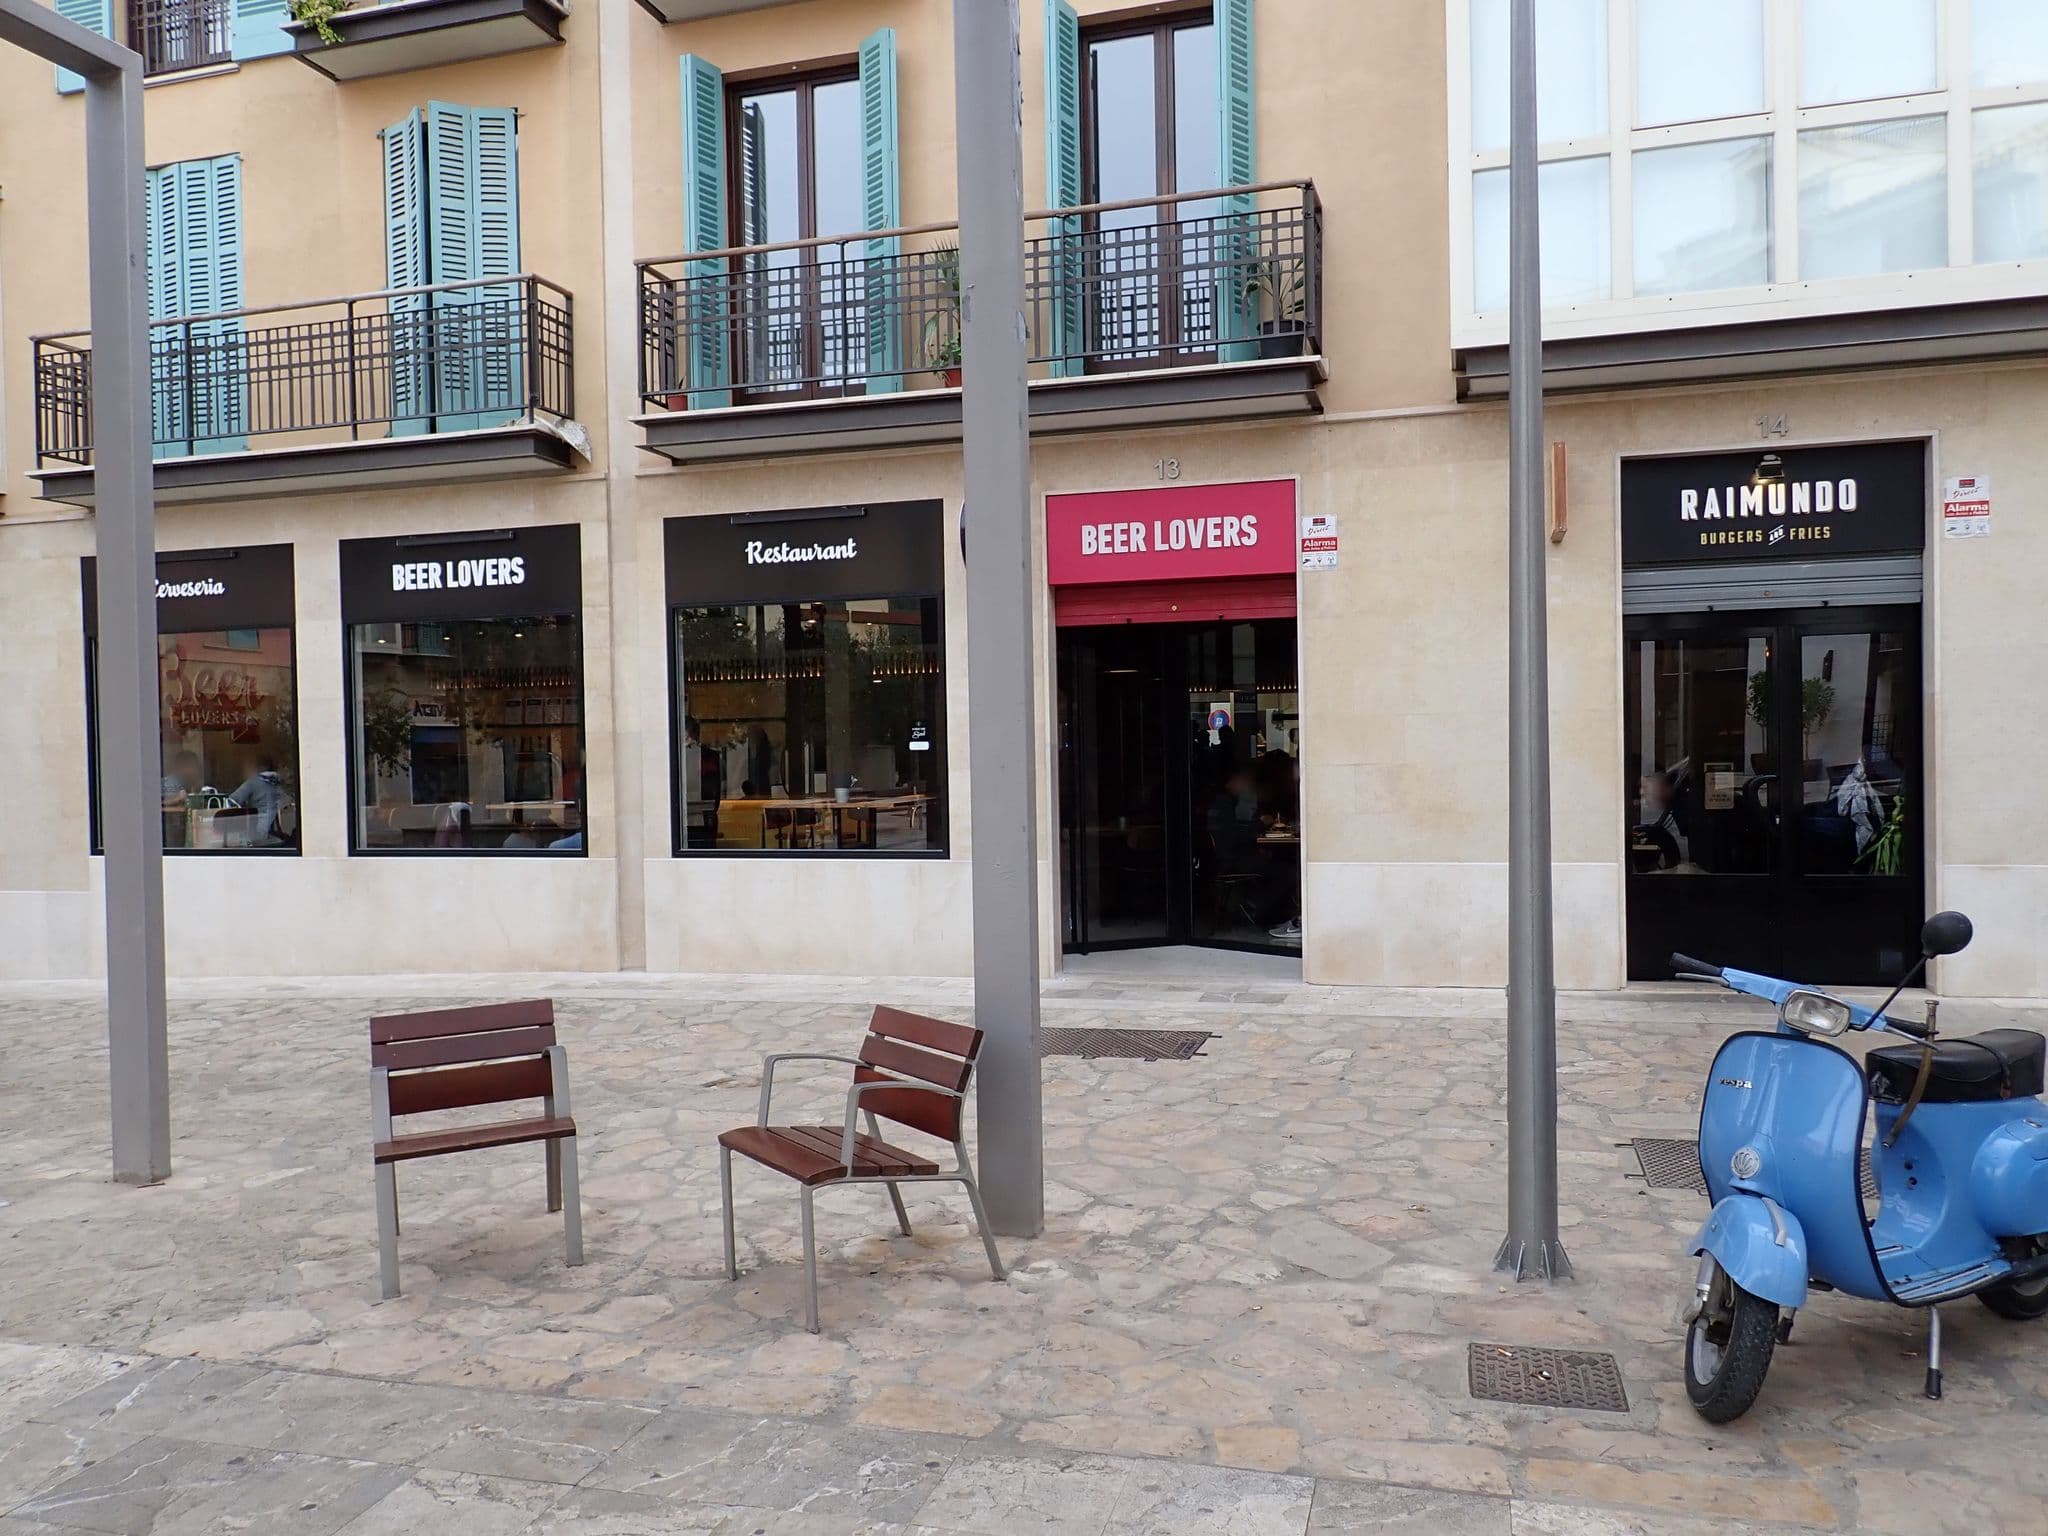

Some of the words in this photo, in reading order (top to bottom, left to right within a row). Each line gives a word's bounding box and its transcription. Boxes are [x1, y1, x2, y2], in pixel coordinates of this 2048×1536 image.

[1757, 414, 1789, 439] 14
[1153, 457, 1181, 480] 13
[1680, 478, 1858, 521] RAIMUNDO
[1946, 503, 1989, 513] Alarma
[1081, 521, 1147, 555] BEER
[1153, 514, 1258, 552] LOVERS
[1303, 539, 1336, 548] Alarma
[1700, 530, 1764, 545] BURGERS
[1789, 526, 1831, 540] FRIES
[744, 537, 858, 565] Restaurant
[392, 562, 443, 591] BEER
[446, 556, 525, 588] LOVERS
[154, 577, 226, 599] erveseria
